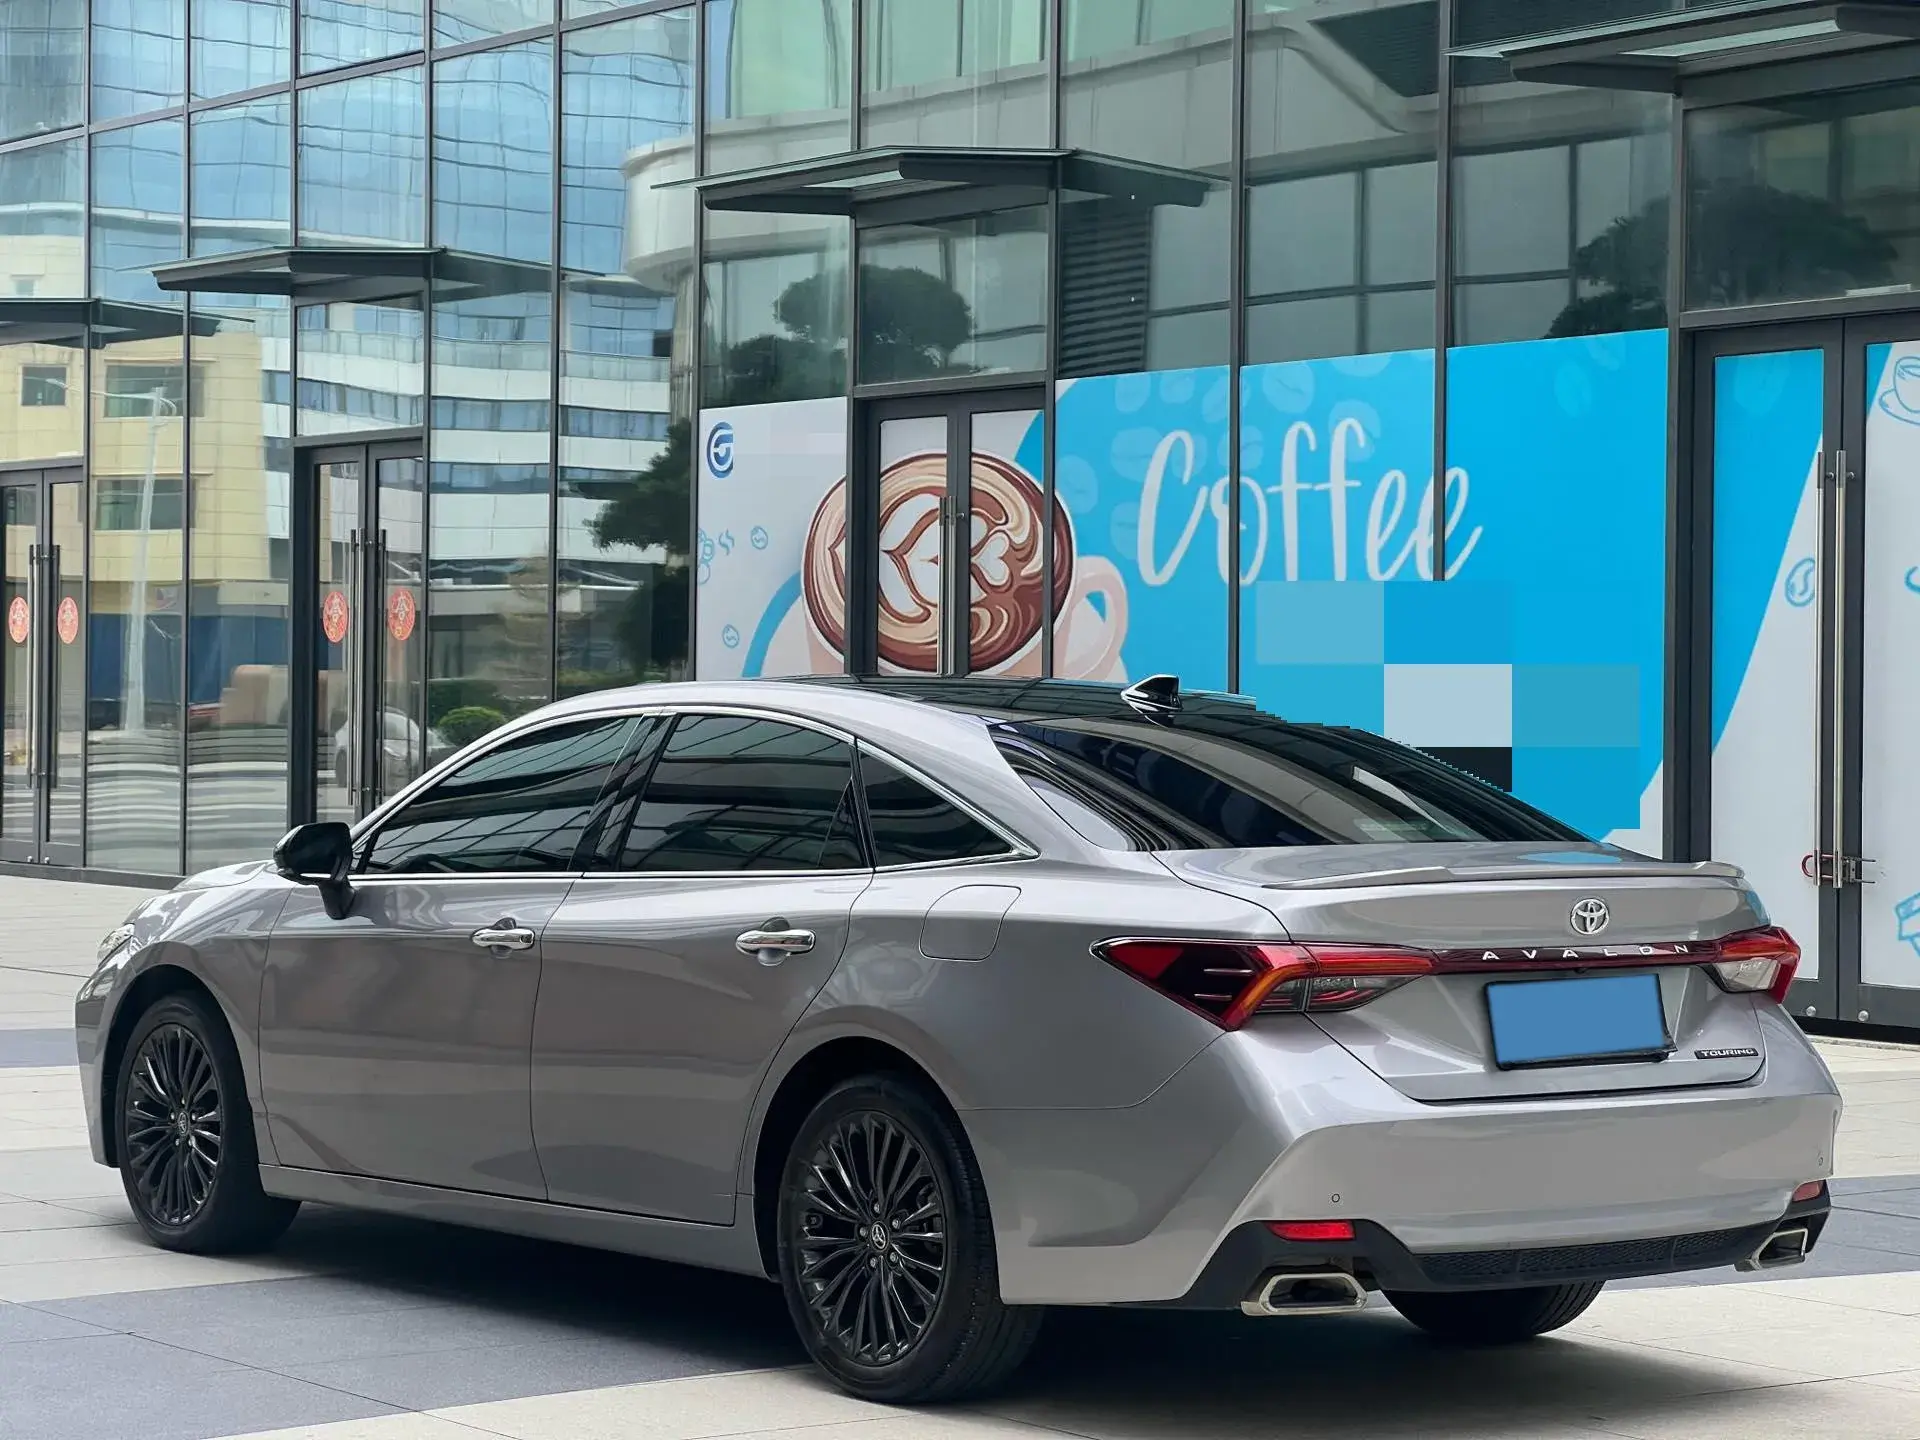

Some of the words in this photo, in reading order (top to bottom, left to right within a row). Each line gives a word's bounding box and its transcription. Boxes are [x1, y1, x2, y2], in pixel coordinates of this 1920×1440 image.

[1137, 417, 1483, 586] Coffee
[1482, 944, 1689, 961] AVALON
[1701, 1048, 1754, 1057] TOURING
